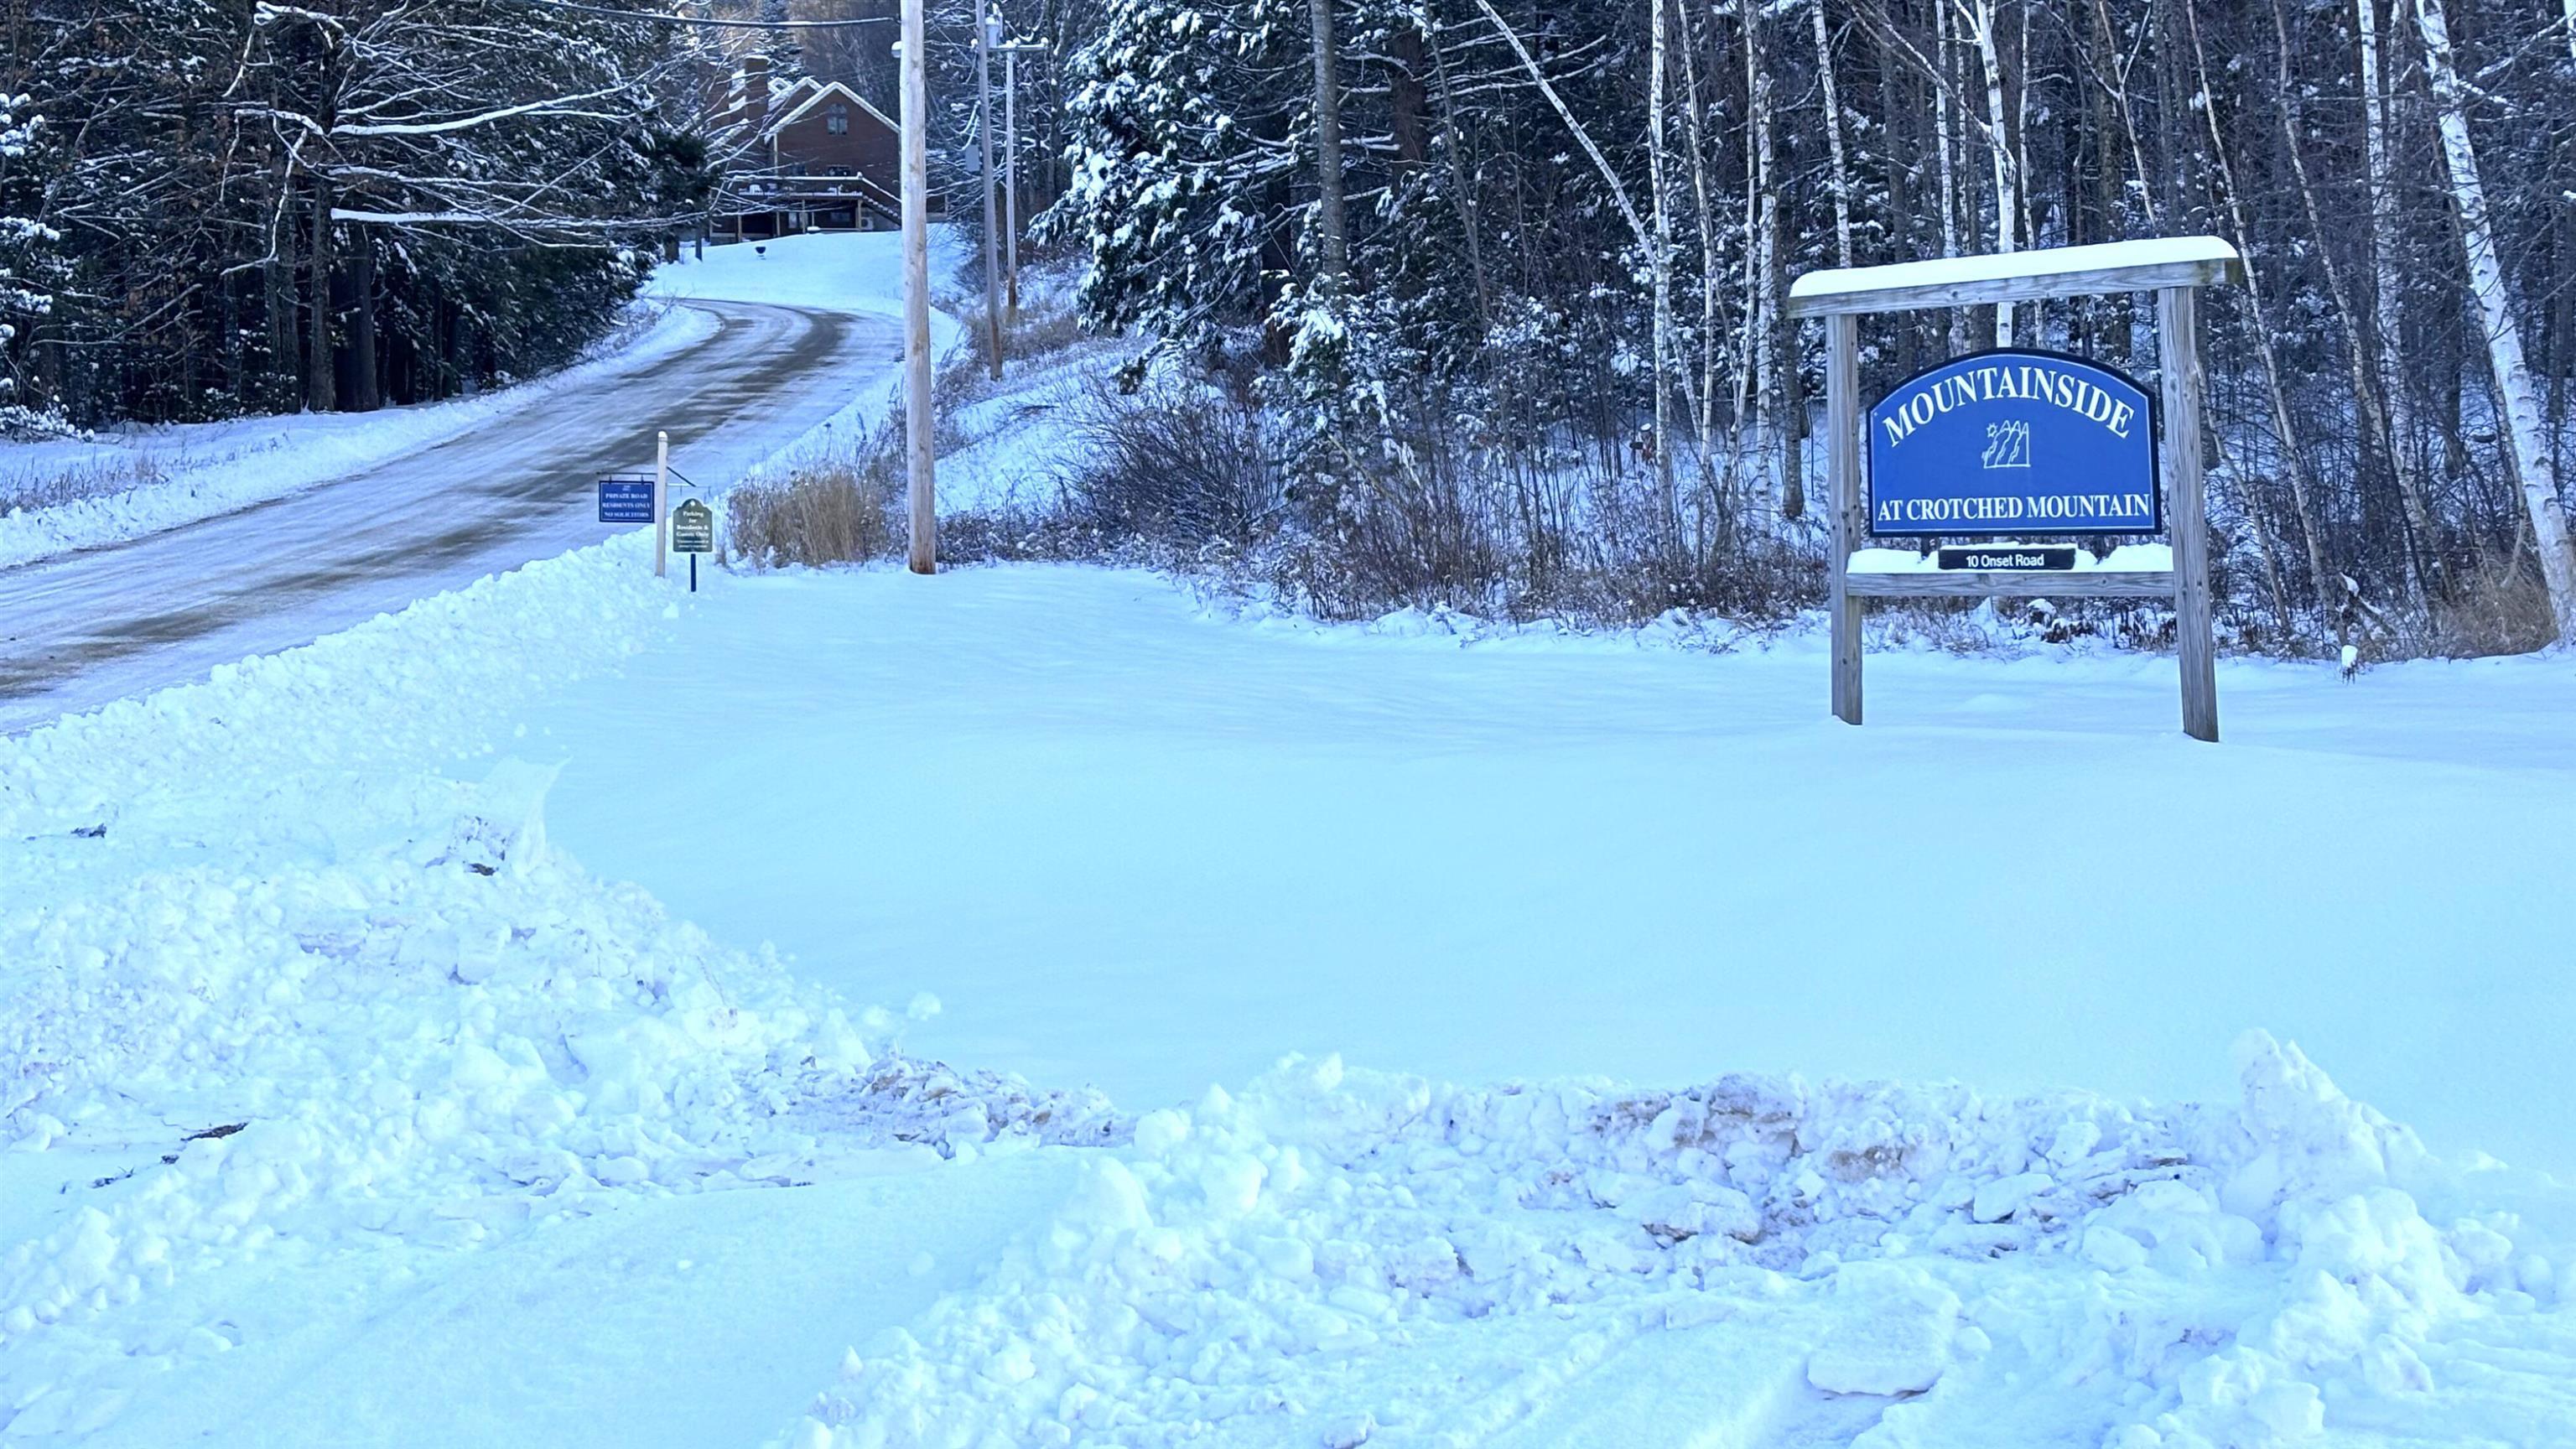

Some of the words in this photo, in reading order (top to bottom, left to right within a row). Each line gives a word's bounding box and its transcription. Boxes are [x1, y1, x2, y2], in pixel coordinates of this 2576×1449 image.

[1883, 366, 2135, 447] MOUNTAINSIDE
[1877, 501, 1903, 522] AT
[1906, 496, 2023, 521] CROTCHED
[2026, 493, 2150, 518] MOUNTAIN
[1966, 555, 1979, 568] 10
[1981, 553, 2013, 567] Onset
[2015, 553, 2044, 567] Road
